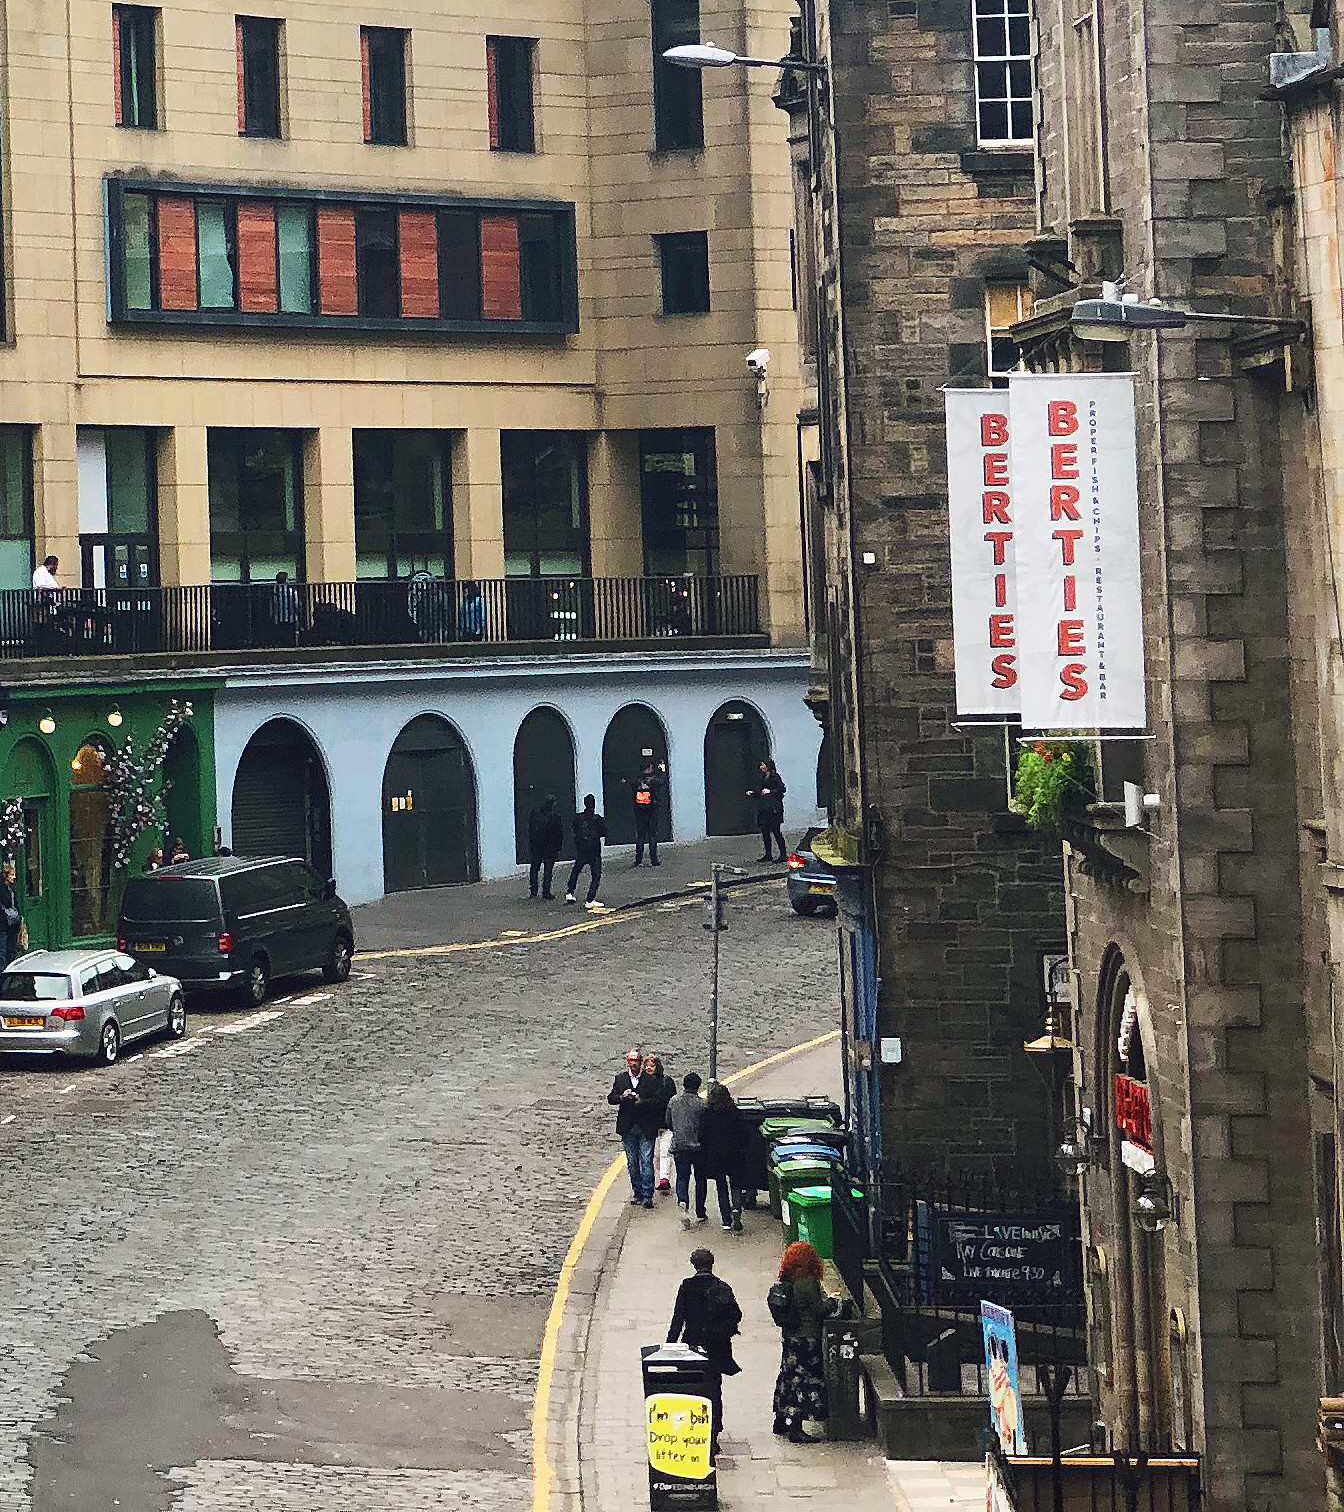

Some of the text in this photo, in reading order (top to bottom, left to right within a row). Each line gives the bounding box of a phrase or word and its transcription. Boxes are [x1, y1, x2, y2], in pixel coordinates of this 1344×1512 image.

[1089, 400, 1097, 455] PROPER
[1091, 457, 1099, 493] FISH
[1092, 496, 1099, 505] &
[980, 413, 1018, 689] BERTIES
[1048, 400, 1089, 701] BERTIES
[1093, 507, 1101, 553] CHIPS
[1095, 567, 1105, 659] RESTAURANT
[1099, 673, 1107, 700] BAR
[649, 1431, 708, 1448] Drop your
